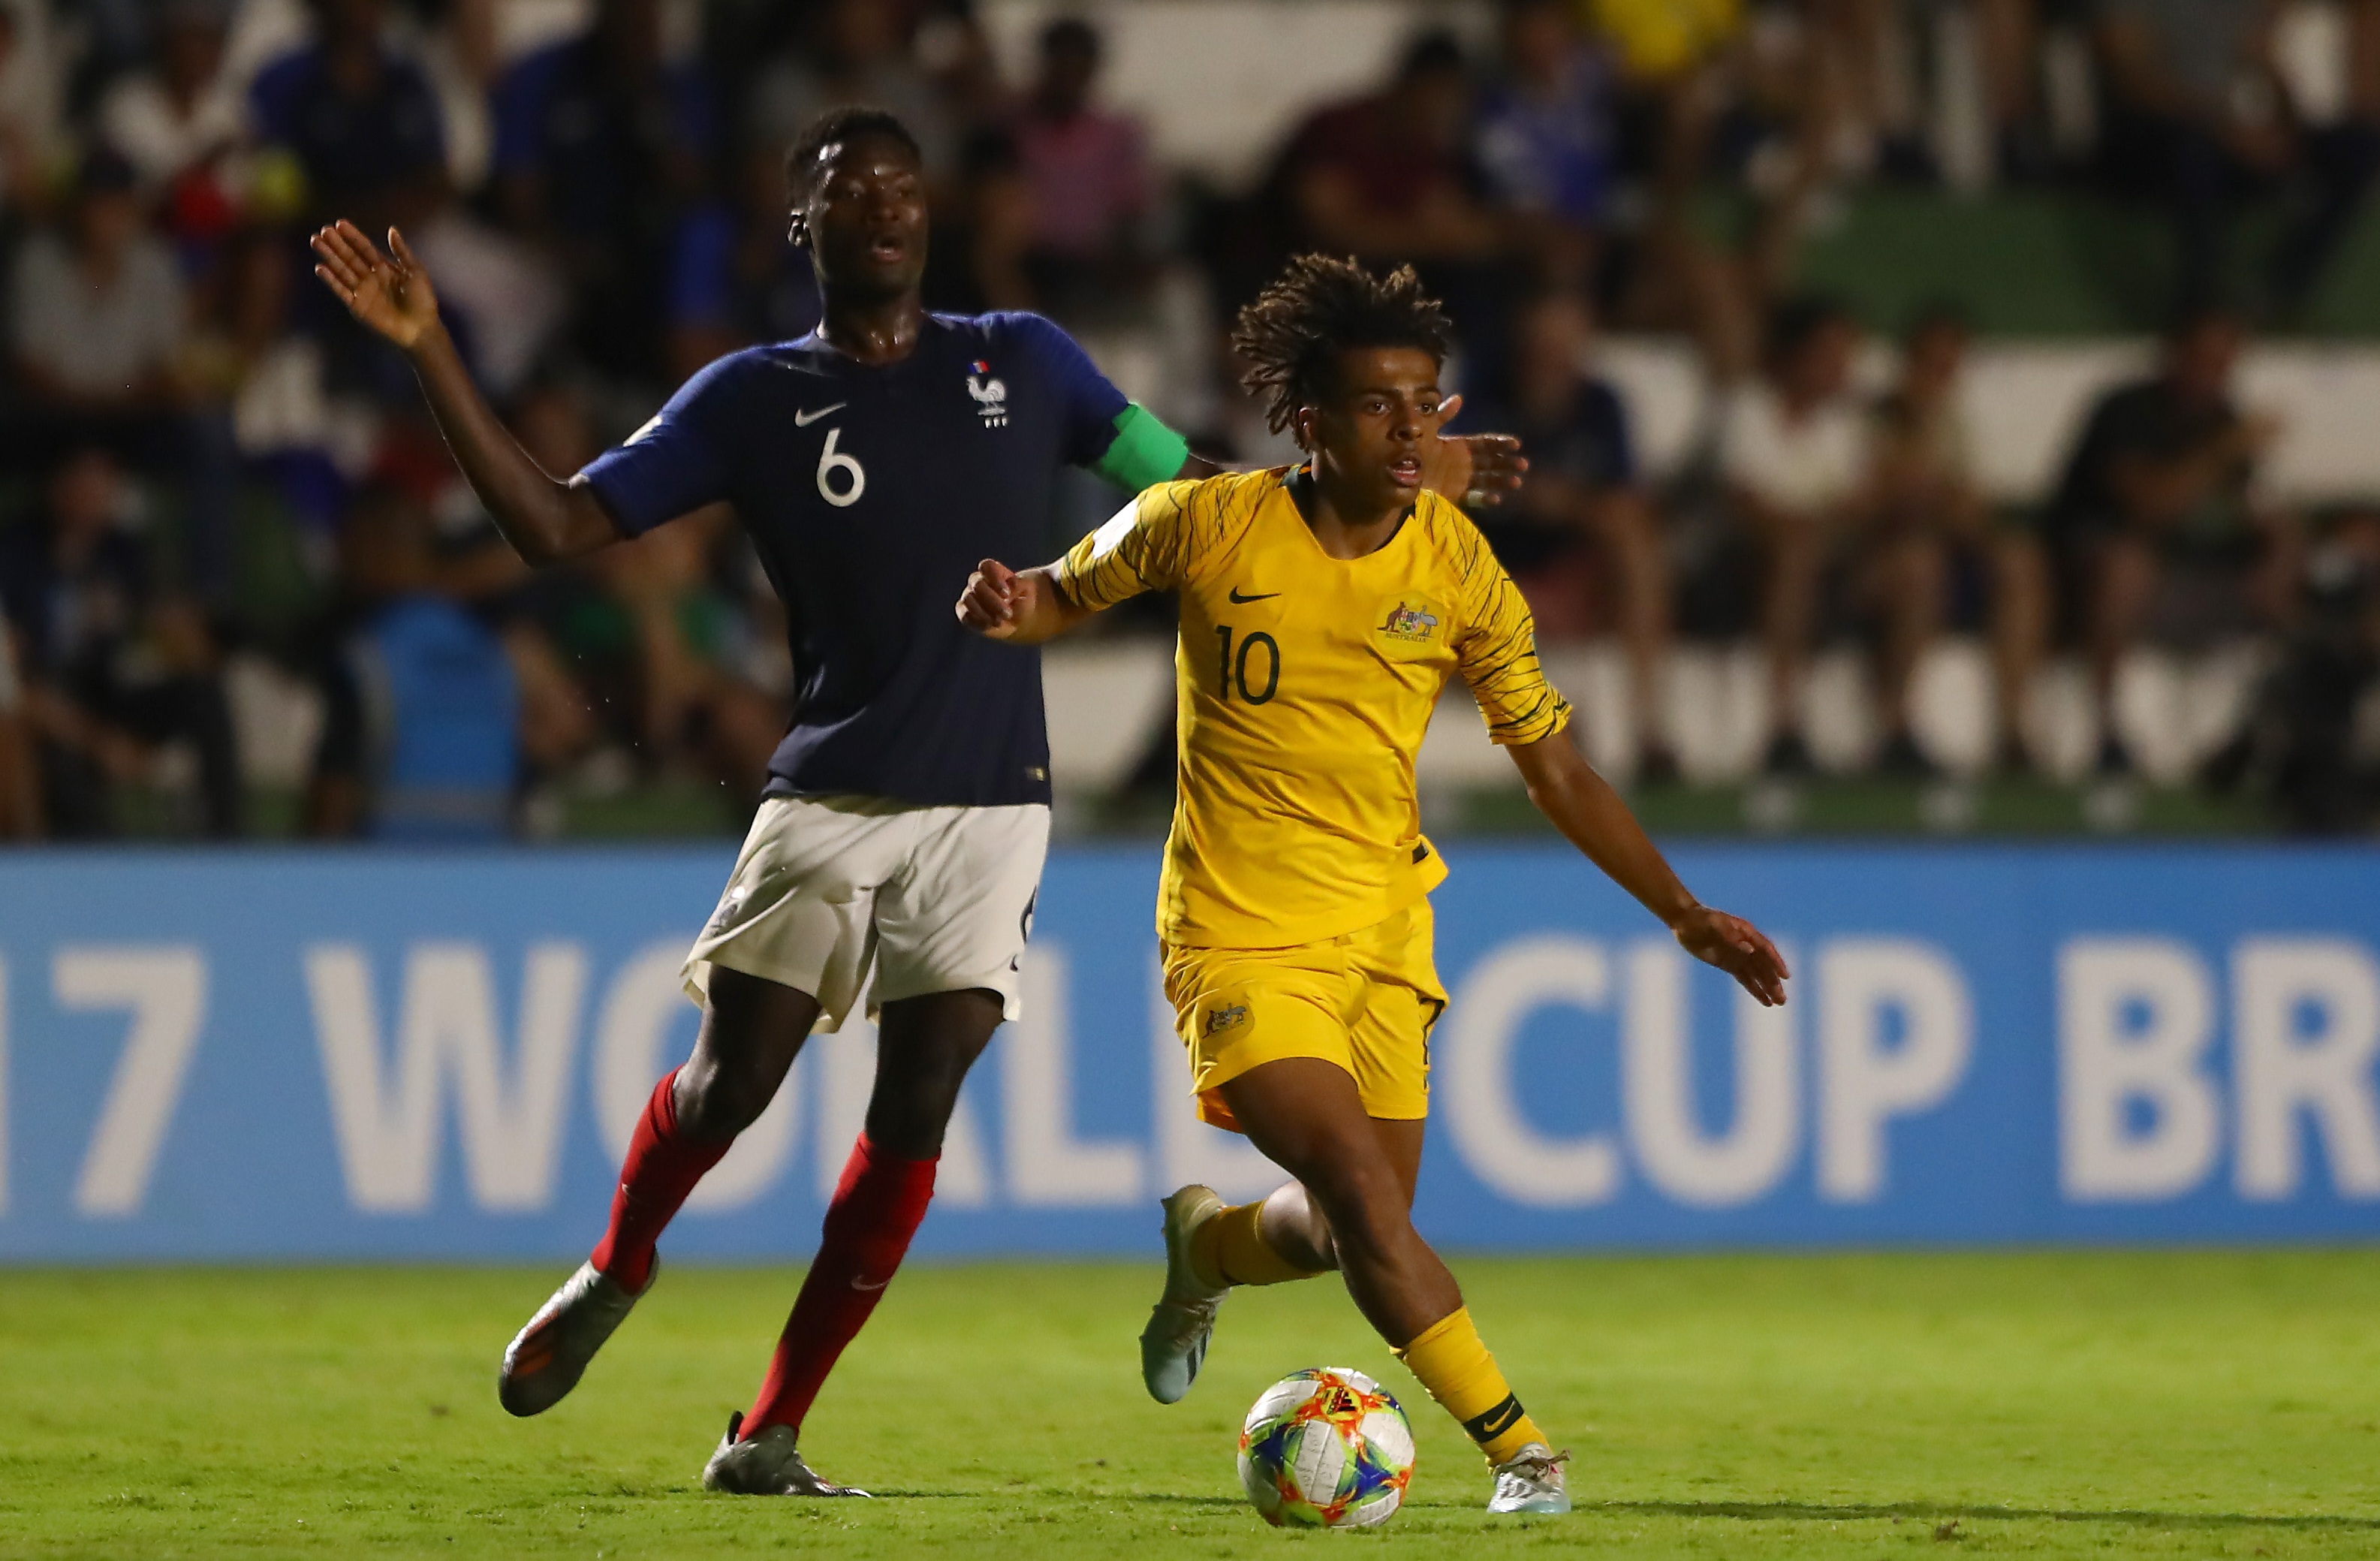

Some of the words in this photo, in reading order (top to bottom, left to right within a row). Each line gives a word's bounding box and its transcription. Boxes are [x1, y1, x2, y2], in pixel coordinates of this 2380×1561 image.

[816, 426, 866, 508] 6
[1216, 625, 1280, 706] 10
[0, 946, 207, 1213] 7
[1440, 936, 1972, 1204] CUP
[2057, 937, 2379, 1200] BR
